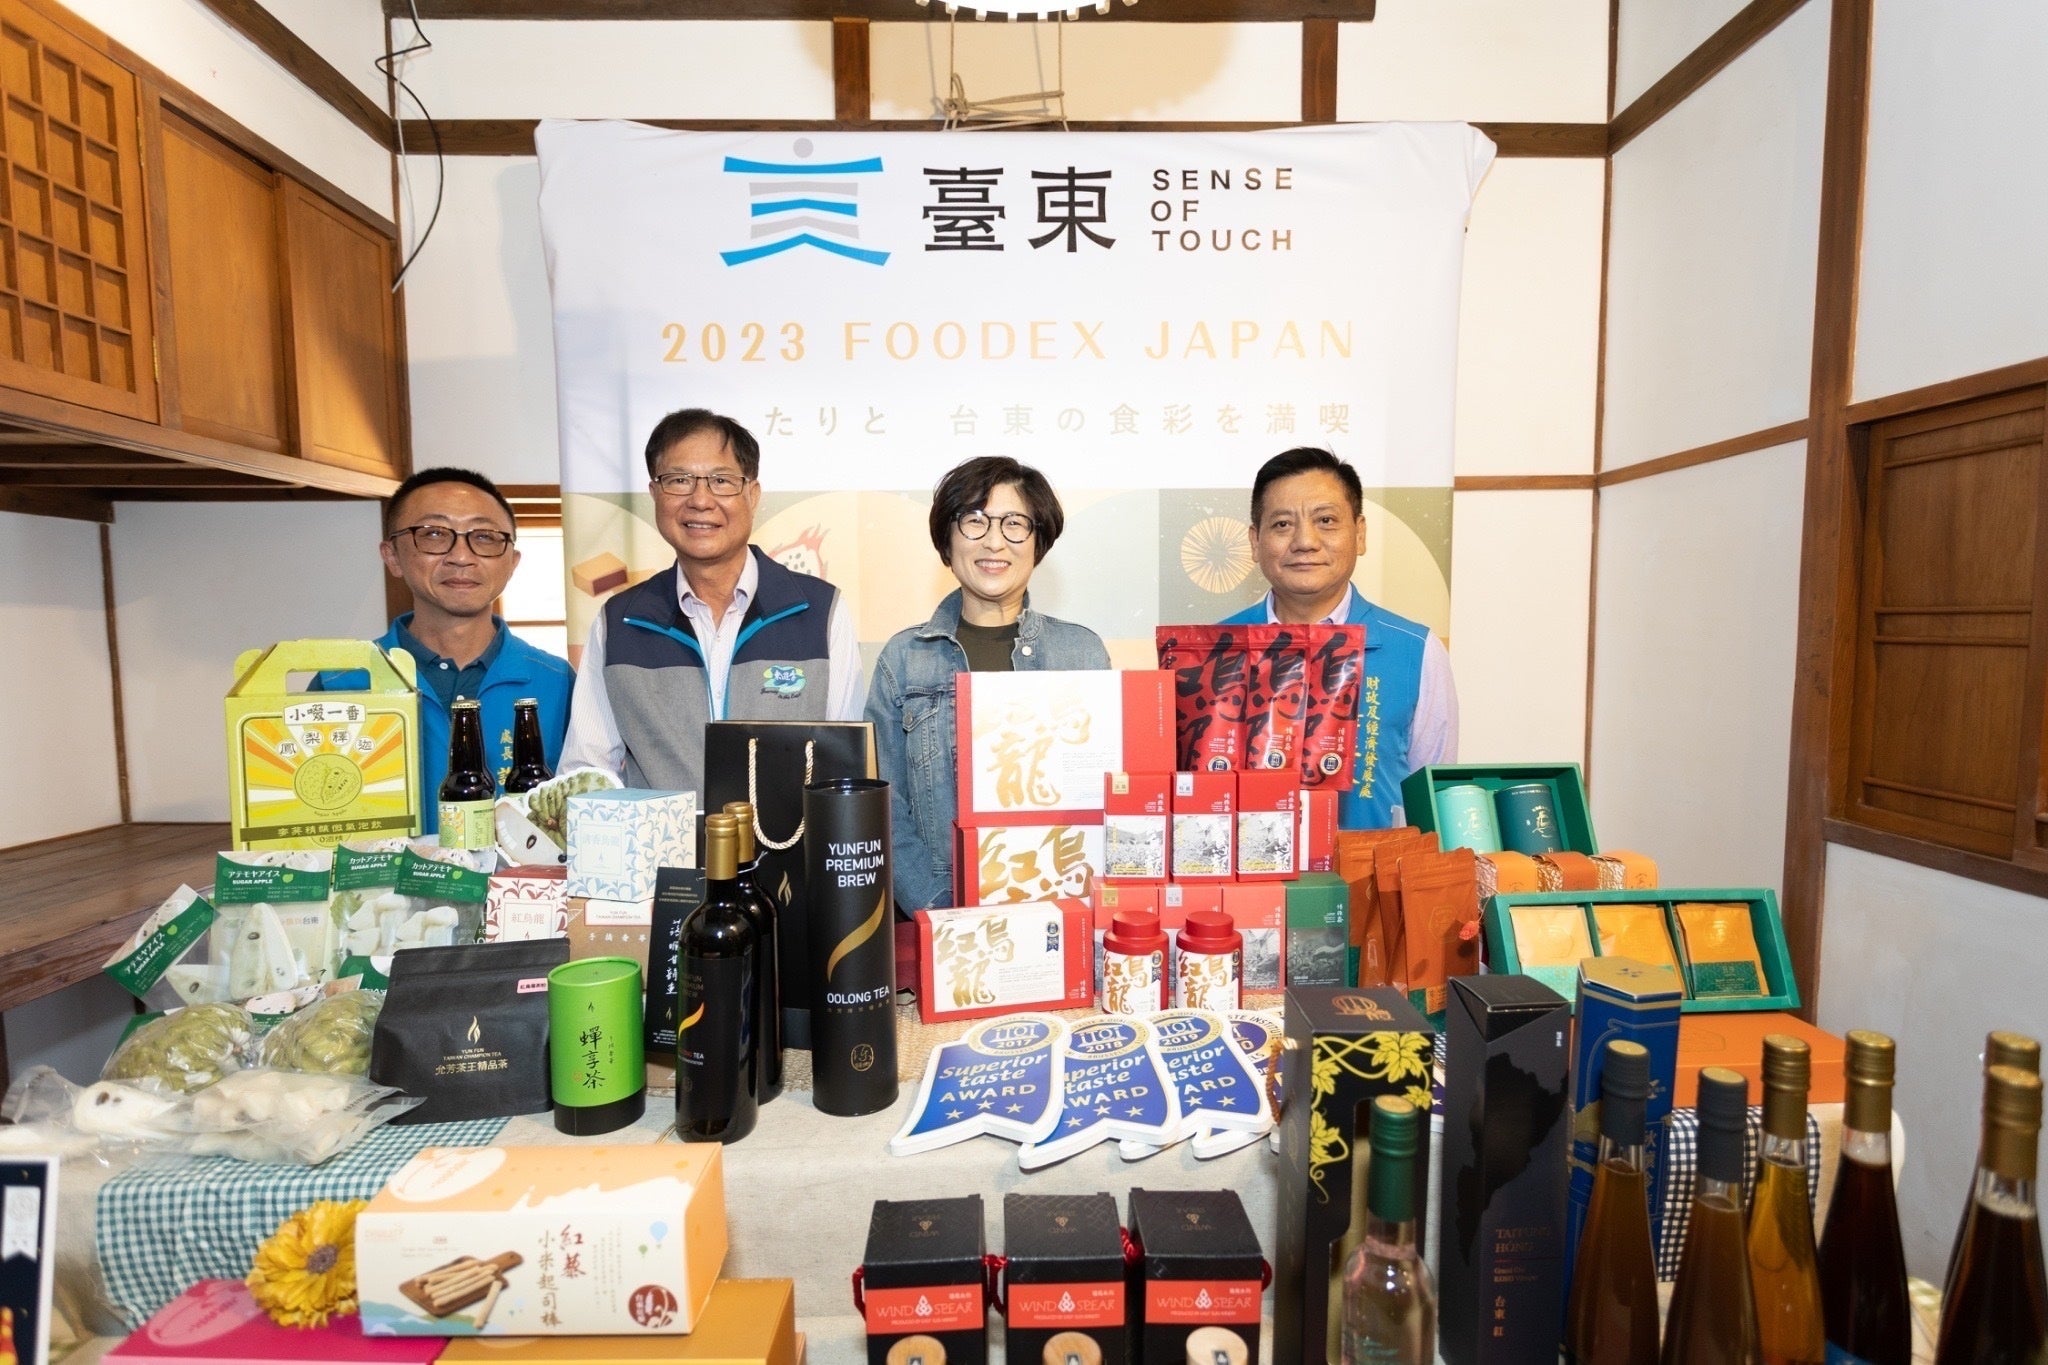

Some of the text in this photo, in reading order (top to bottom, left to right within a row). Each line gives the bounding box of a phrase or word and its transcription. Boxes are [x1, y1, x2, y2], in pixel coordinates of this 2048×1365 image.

[1152, 168, 1294, 191] SENSE
[922, 166, 1117, 252] 臺東
[1151, 200, 1199, 223] OF
[1152, 230, 1293, 252] TOUCH
[661, 319, 1354, 363] 2023 FOODEX JAPAN
[765, 403, 1350, 437] たりと 台東の食彩を満喫
[289, 703, 360, 722] 小啜一番
[1359, 676, 1380, 798] 財政及經濟發展處
[828, 839, 882, 856] YUNFUN
[826, 854, 884, 871] PREMIUM
[228, 870, 281, 879] アテモヤアイス
[838, 872, 876, 887] BREW
[827, 985, 890, 1005] OOLONG TEA
[996, 1038, 1034, 1049] 2017
[1086, 1039, 1124, 1053] 2018
[1162, 1033, 1199, 1046] 2019
[693, 1052, 704, 1060] TEA
[1168, 1045, 1225, 1070] erior
[939, 1053, 1049, 1080] Superior
[959, 1067, 1026, 1089] taste
[1184, 1076, 1237, 1096] ARD
[939, 1084, 1037, 1103] AWARD
[536, 1229, 563, 1328] 小米起司棒
[876, 1300, 974, 1318] WIND SPEAR
[1019, 1298, 1116, 1313] WIND SPEAR
[1157, 1296, 1252, 1309] WIND SPEAR
